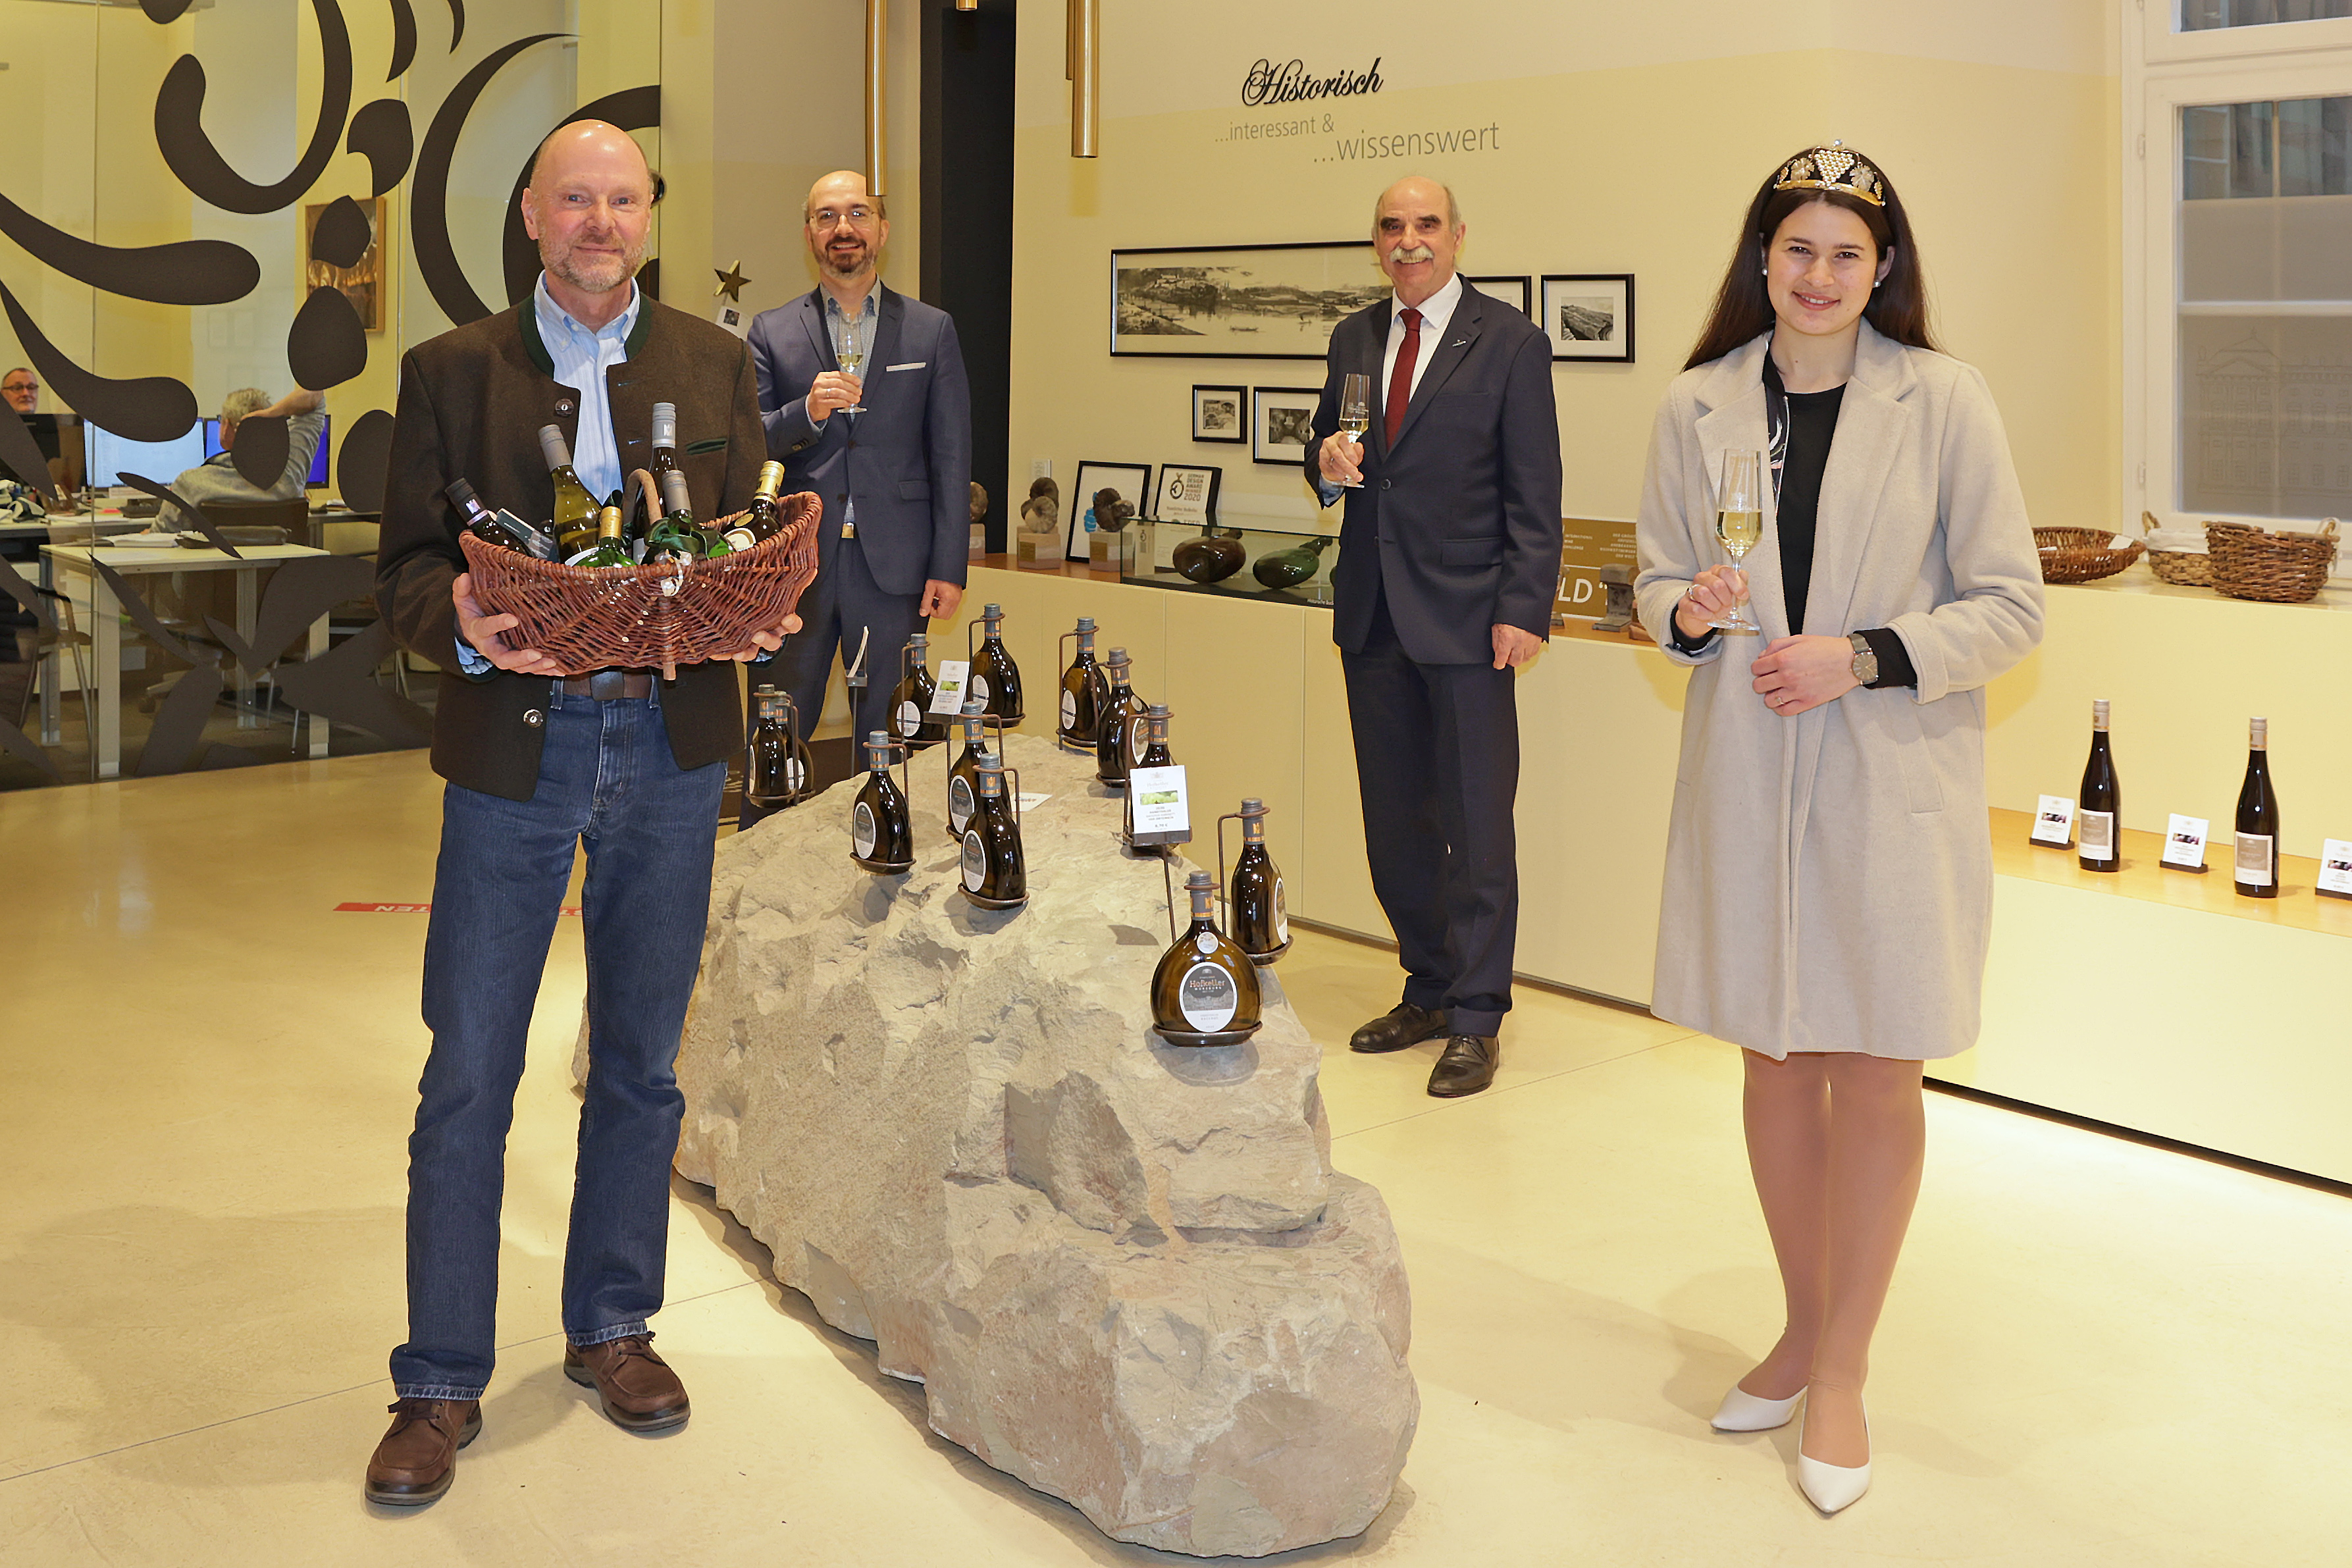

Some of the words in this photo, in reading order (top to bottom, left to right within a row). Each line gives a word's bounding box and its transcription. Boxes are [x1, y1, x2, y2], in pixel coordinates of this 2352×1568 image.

[1241, 57, 1384, 107] Historisch
[1215, 115, 1316, 143] ...interessant
[1322, 113, 1335, 133] &
[1313, 122, 1500, 163] ...wissenswert
[1184, 493, 1201, 502] 2020
[1557, 577, 1593, 603] LD
[1189, 978, 1225, 988] Hofkeller
